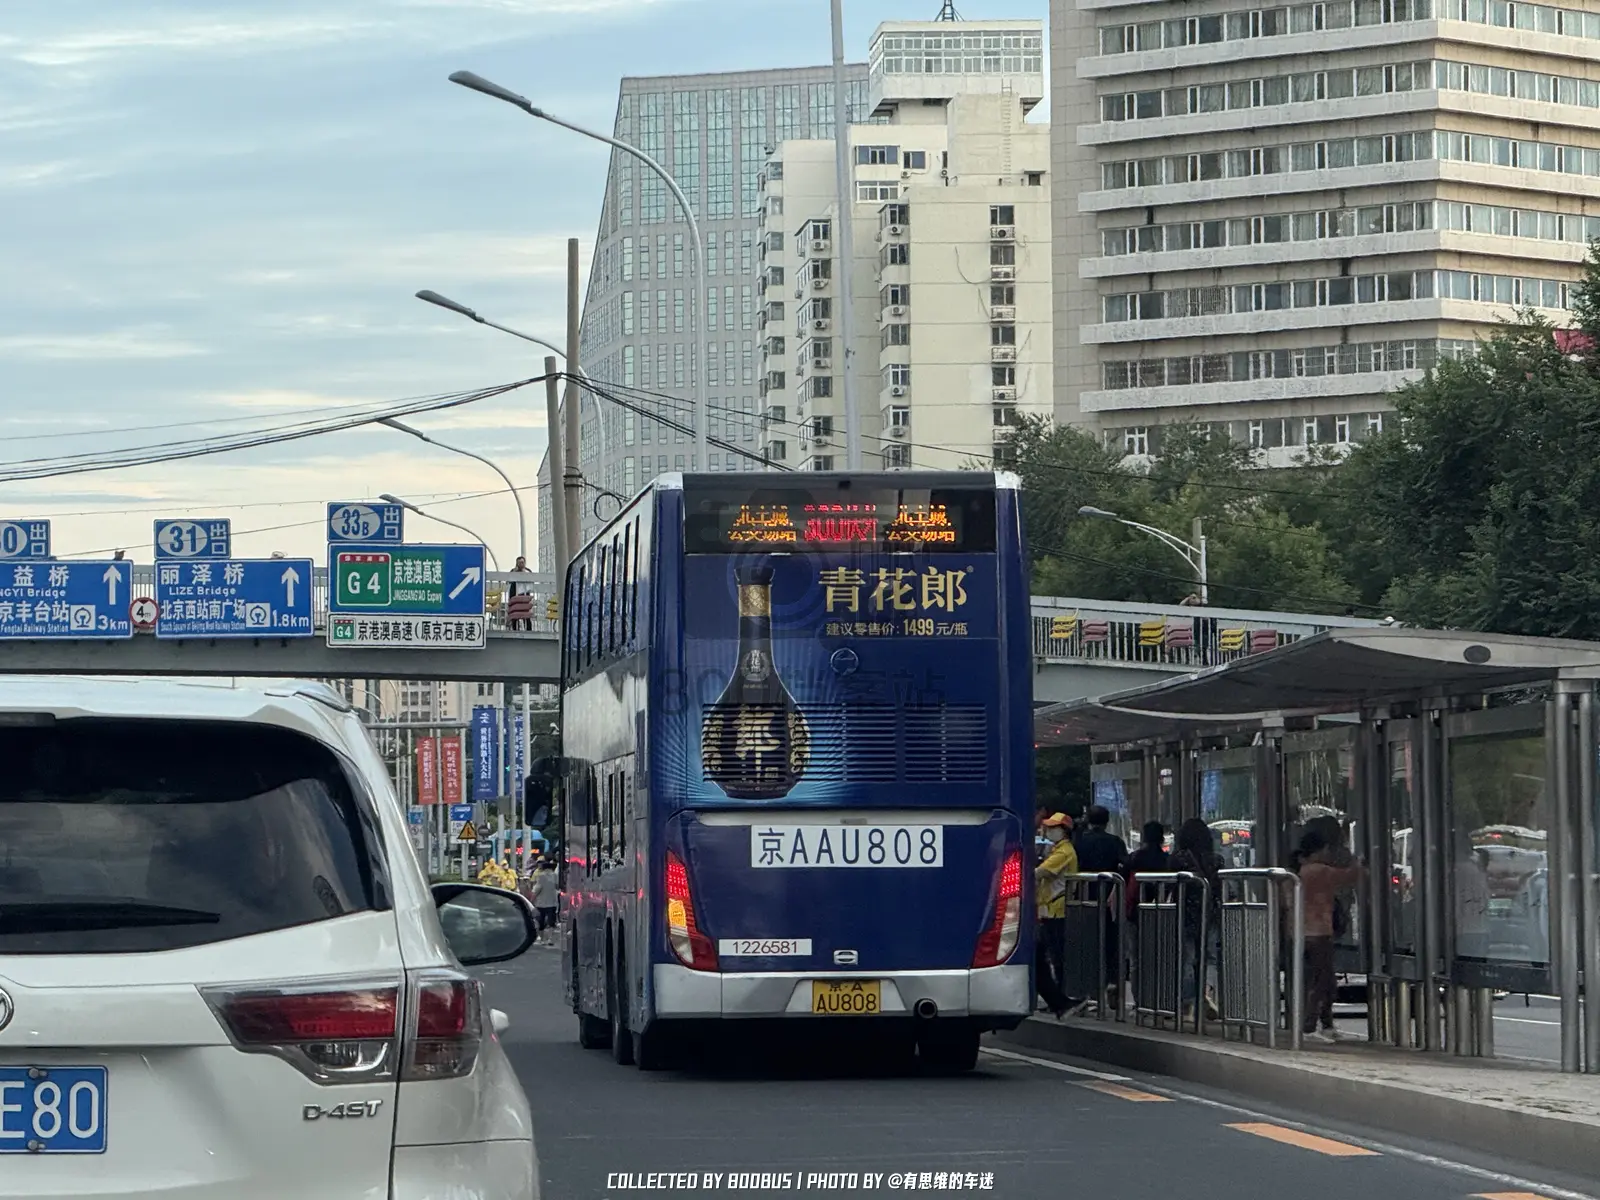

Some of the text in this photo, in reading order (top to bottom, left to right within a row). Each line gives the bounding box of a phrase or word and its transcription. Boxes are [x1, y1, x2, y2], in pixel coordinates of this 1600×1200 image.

[383, 507, 400, 539] 出口
[30, 523, 47, 556] 出口
[169, 525, 197, 553] 31
[210, 522, 228, 555] 出口
[160, 563, 245, 585] 丽泽桥
[394, 559, 442, 585] 京港澳高速
[27, 588, 67, 600] Bridge
[169, 586, 237, 597] LIZE Bridge
[818, 566, 968, 613] 青花郎
[0, 600, 70, 623] 京丰台站
[160, 599, 246, 620] 北京西站南广场
[272, 609, 310, 627] 1.8km
[97, 614, 128, 631] 3km
[336, 625, 352, 638] G4
[358, 620, 482, 642] 京港澳高速(原京石高速)
[757, 827, 939, 867] 京AAU808
[732, 940, 798, 955] 1226581
[816, 993, 877, 1012] AU808
[0, 1080, 99, 1139] E80
[303, 1100, 383, 1121] D-4ST
